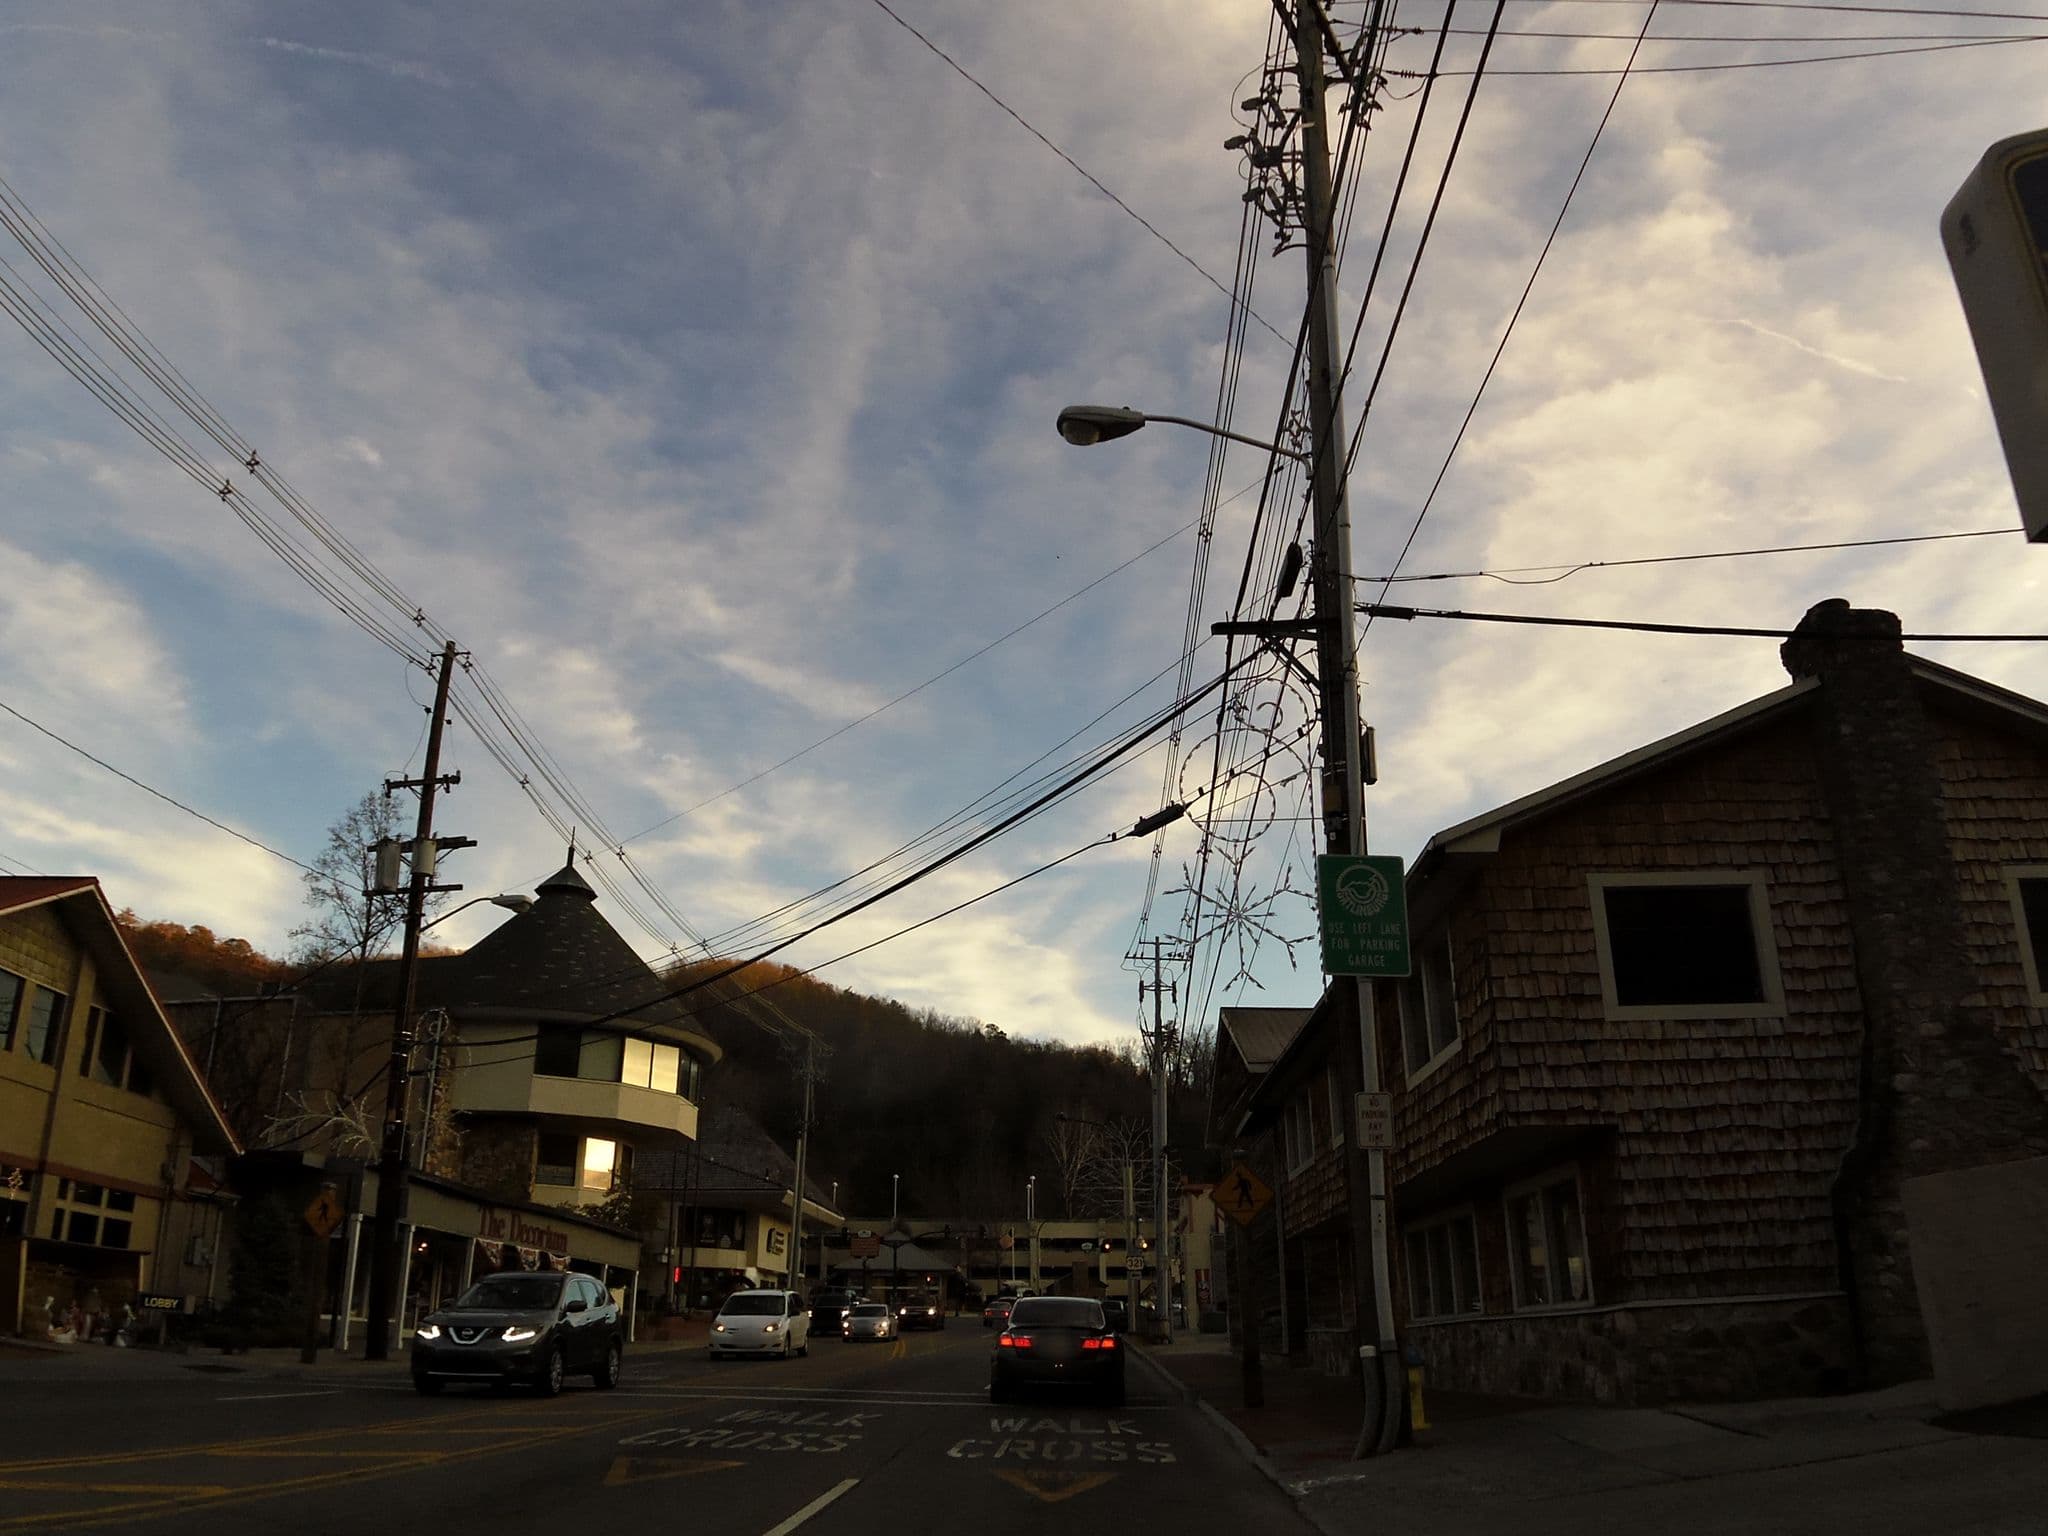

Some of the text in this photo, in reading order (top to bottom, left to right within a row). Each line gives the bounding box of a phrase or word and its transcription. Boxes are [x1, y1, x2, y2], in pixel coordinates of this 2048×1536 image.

[1352, 922, 1372, 935] LEFT
[1380, 922, 1401, 935] LANE
[1331, 938, 1400, 951] FOR PARKING
[1348, 954, 1385, 967] GARAGE
[480, 1207, 505, 1239] The
[1127, 1258, 1143, 1269] 321
[144, 1297, 180, 1309] LOBBY
[715, 1409, 883, 1427] WALK
[991, 1418, 1143, 1435] WALK
[618, 1428, 863, 1453] CROSS
[947, 1439, 1177, 1463] CROSS
